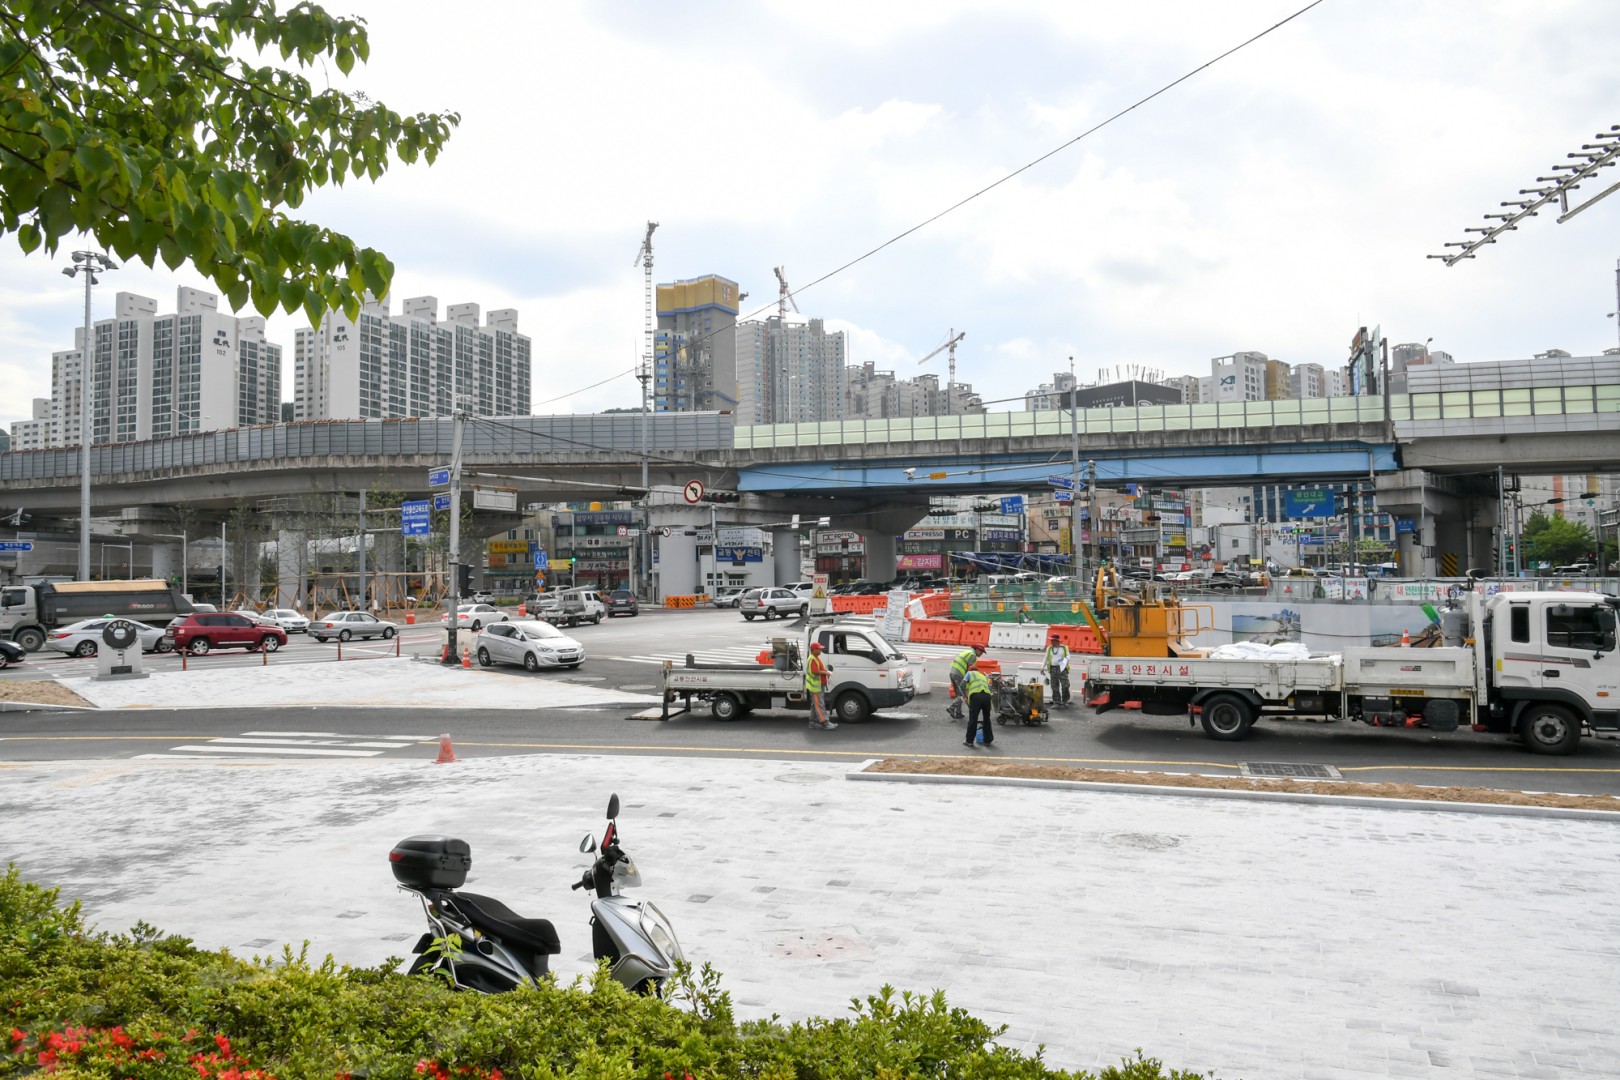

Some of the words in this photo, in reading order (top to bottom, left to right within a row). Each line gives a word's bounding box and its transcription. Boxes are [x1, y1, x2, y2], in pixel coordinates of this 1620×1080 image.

[216, 349, 227, 357] 102
[954, 530, 970, 539] PC
[917, 557, 939, 567] 감자탕
[1396, 585, 1404, 596] 내
[1100, 664, 1189, 677] 교통안전시설
[673, 675, 708, 683] 교통안전시설
